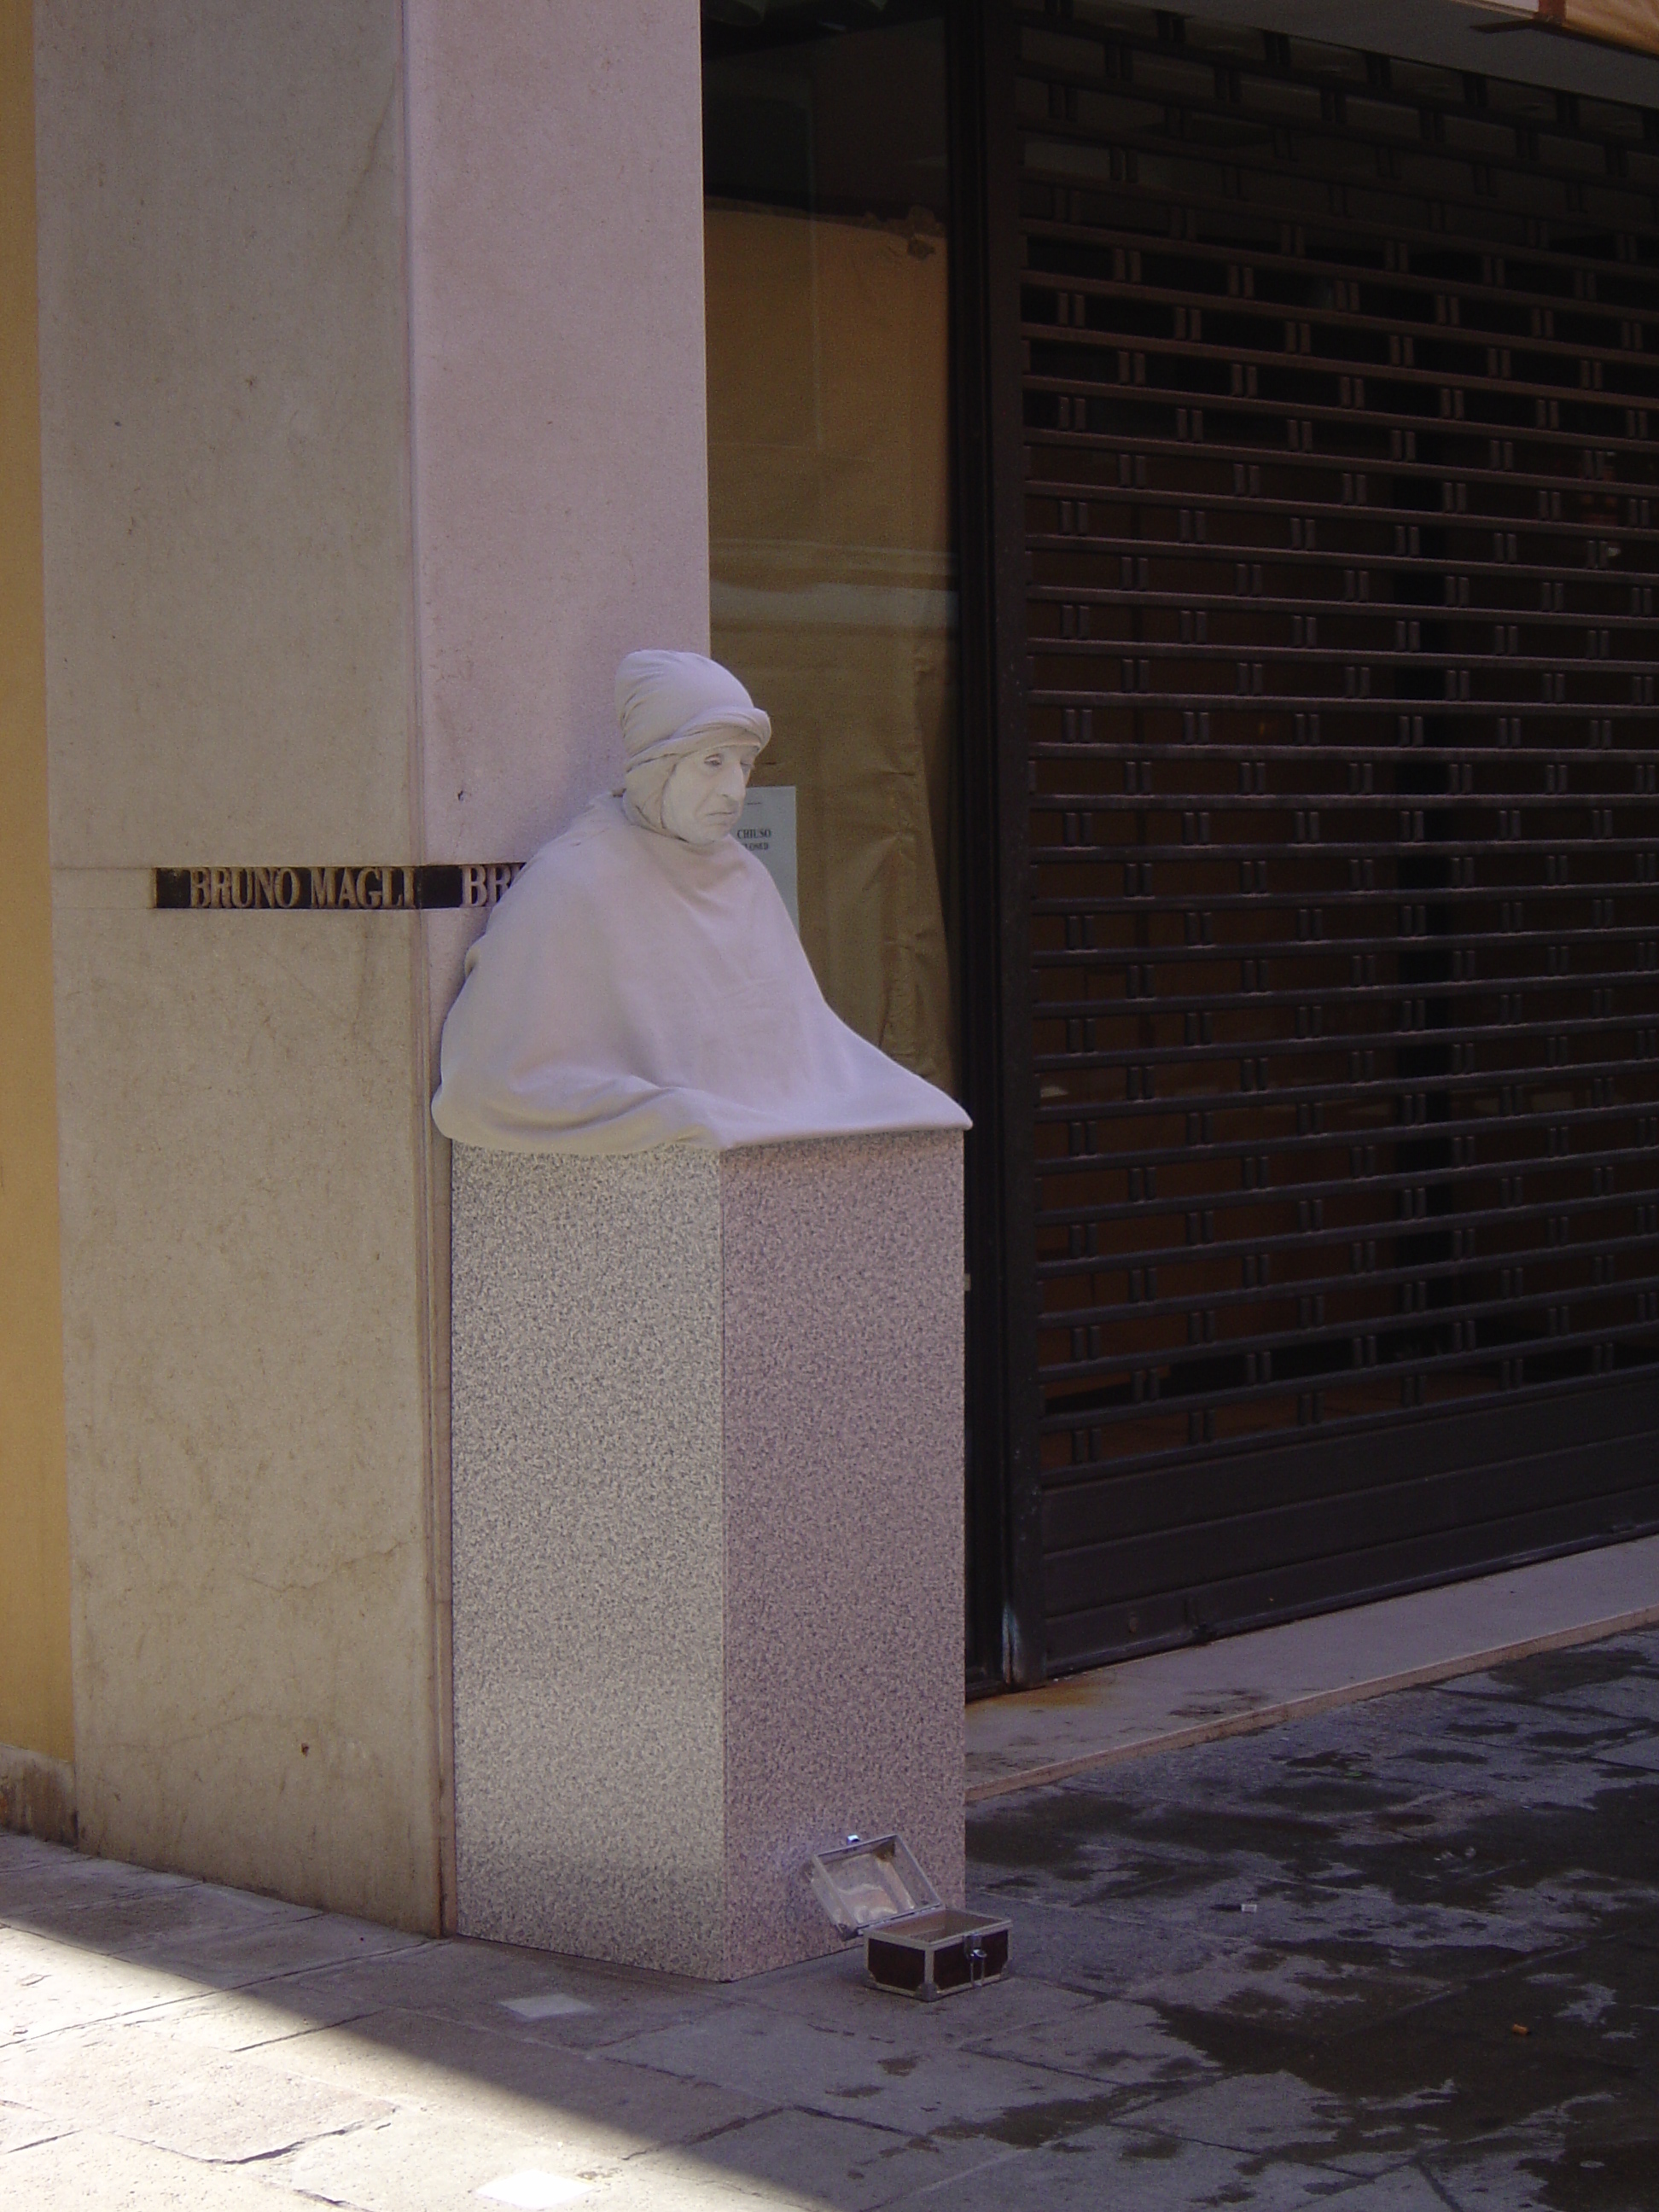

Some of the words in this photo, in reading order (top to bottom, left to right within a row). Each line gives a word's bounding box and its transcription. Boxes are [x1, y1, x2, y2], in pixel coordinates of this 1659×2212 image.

[742, 842, 769, 851] LOSED
[189, 867, 300, 908] BRUNO
[310, 866, 415, 908] MAGLI
[460, 864, 521, 907] BR
